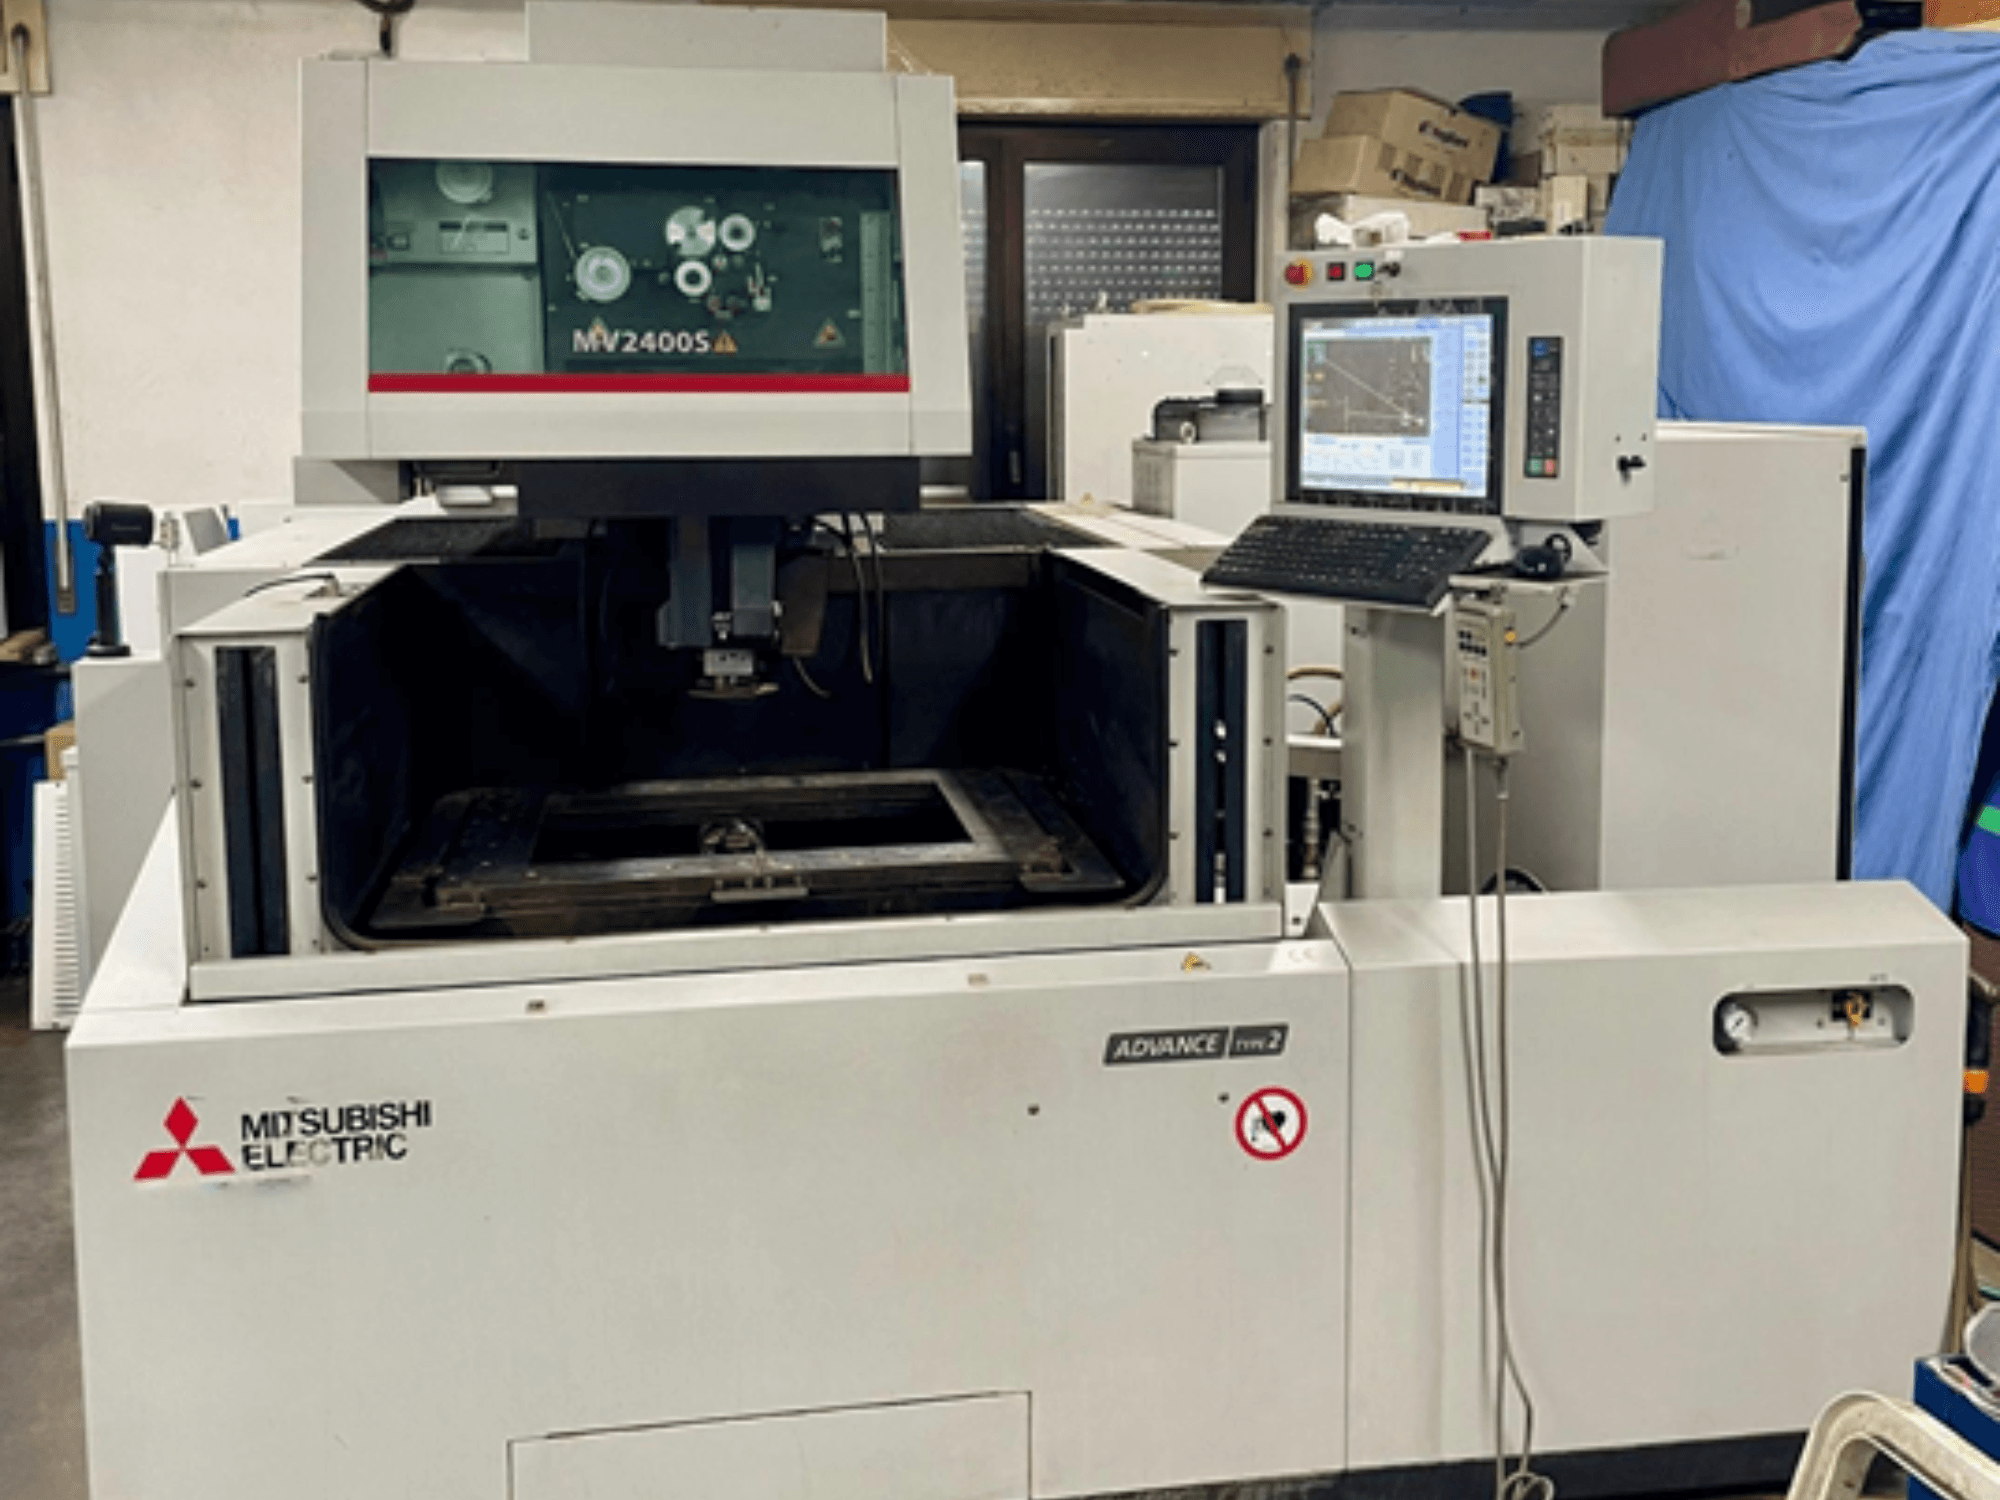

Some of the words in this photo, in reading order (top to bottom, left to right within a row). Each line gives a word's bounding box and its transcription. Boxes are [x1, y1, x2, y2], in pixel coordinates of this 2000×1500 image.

[573, 329, 710, 352] MV2400S
[1113, 1033, 1219, 1059] ADVANCE
[1268, 1029, 1282, 1049] 2
